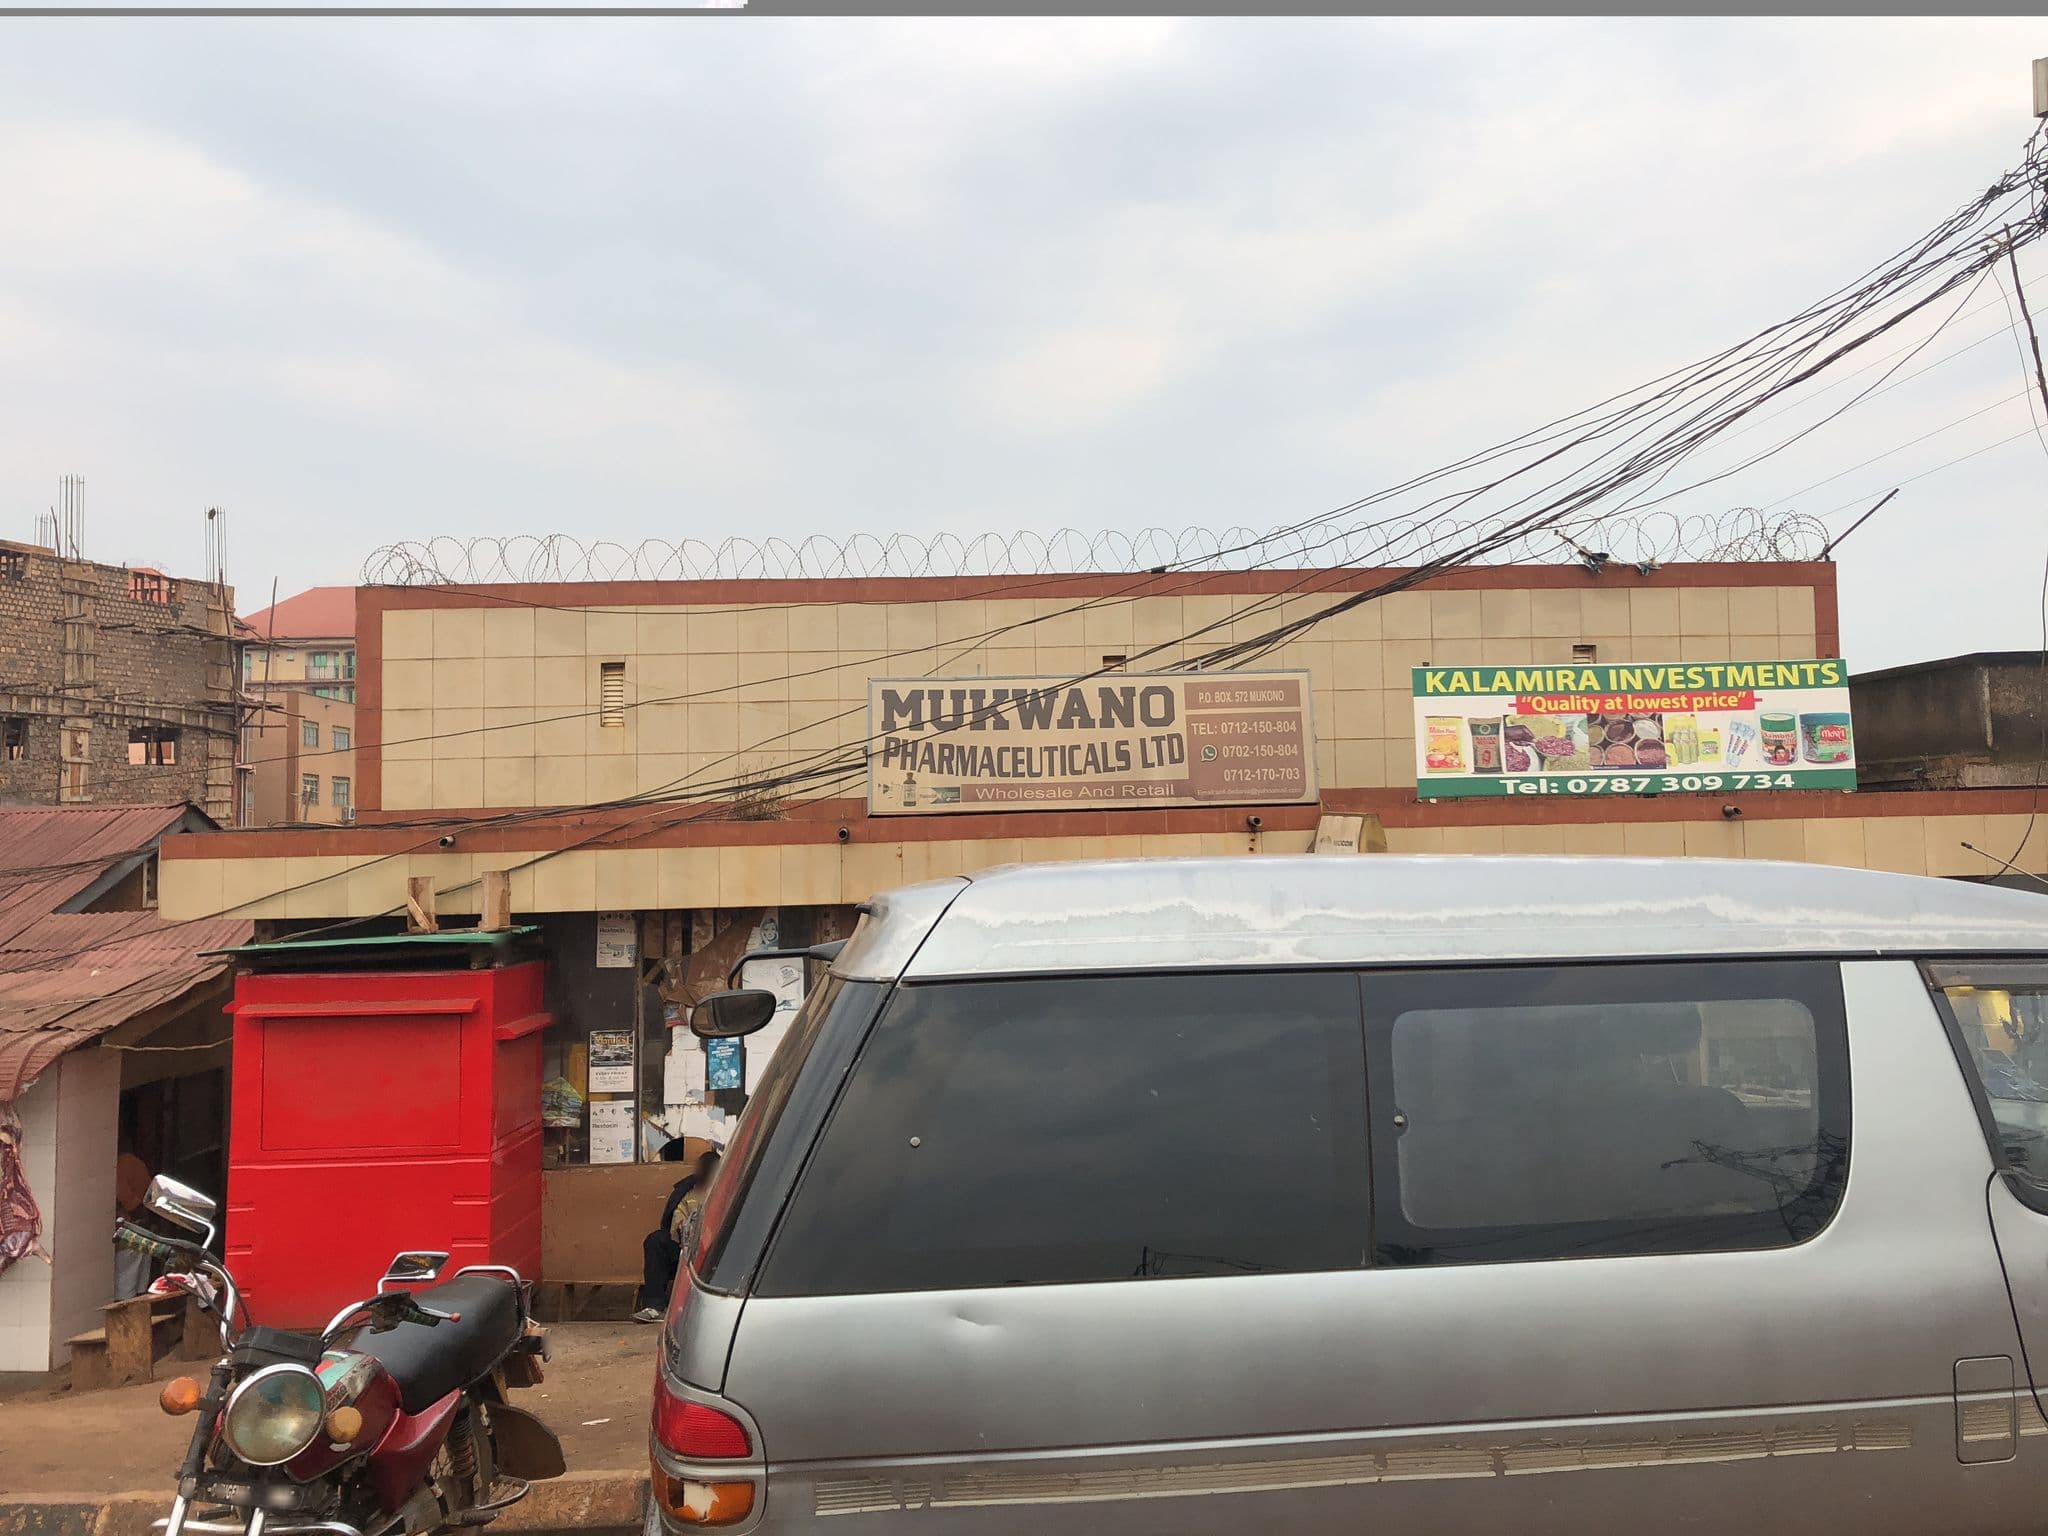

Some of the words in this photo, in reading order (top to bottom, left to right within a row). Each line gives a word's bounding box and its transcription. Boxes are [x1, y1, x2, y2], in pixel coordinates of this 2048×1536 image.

[1425, 669, 1601, 693] KALAMIRA
[1609, 662, 1841, 692] INVESTMENTS
[1234, 691, 1248, 702] 572
[1249, 690, 1285, 702] MUKONO
[1604, 697, 1625, 710] at
[1627, 693, 1689, 710] lowest
[881, 686, 1176, 732] MUKWANO
[1191, 723, 1218, 735] TEL:
[1220, 721, 1297, 735] 0712-150-804
[882, 736, 1132, 778] PHARMACEUTICALS
[1139, 732, 1185, 769] LTD
[1222, 744, 1299, 758] 0702-150-804
[1223, 768, 1300, 781] 0712-170-703
[975, 786, 1074, 800] Wholesale
[1078, 786, 1115, 798] And
[1122, 784, 1175, 797] Retail
[1500, 778, 1559, 795] Tel:
[1567, 777, 1650, 794] 0787
[1661, 775, 1723, 792] 309
[1732, 773, 1796, 790] 734
